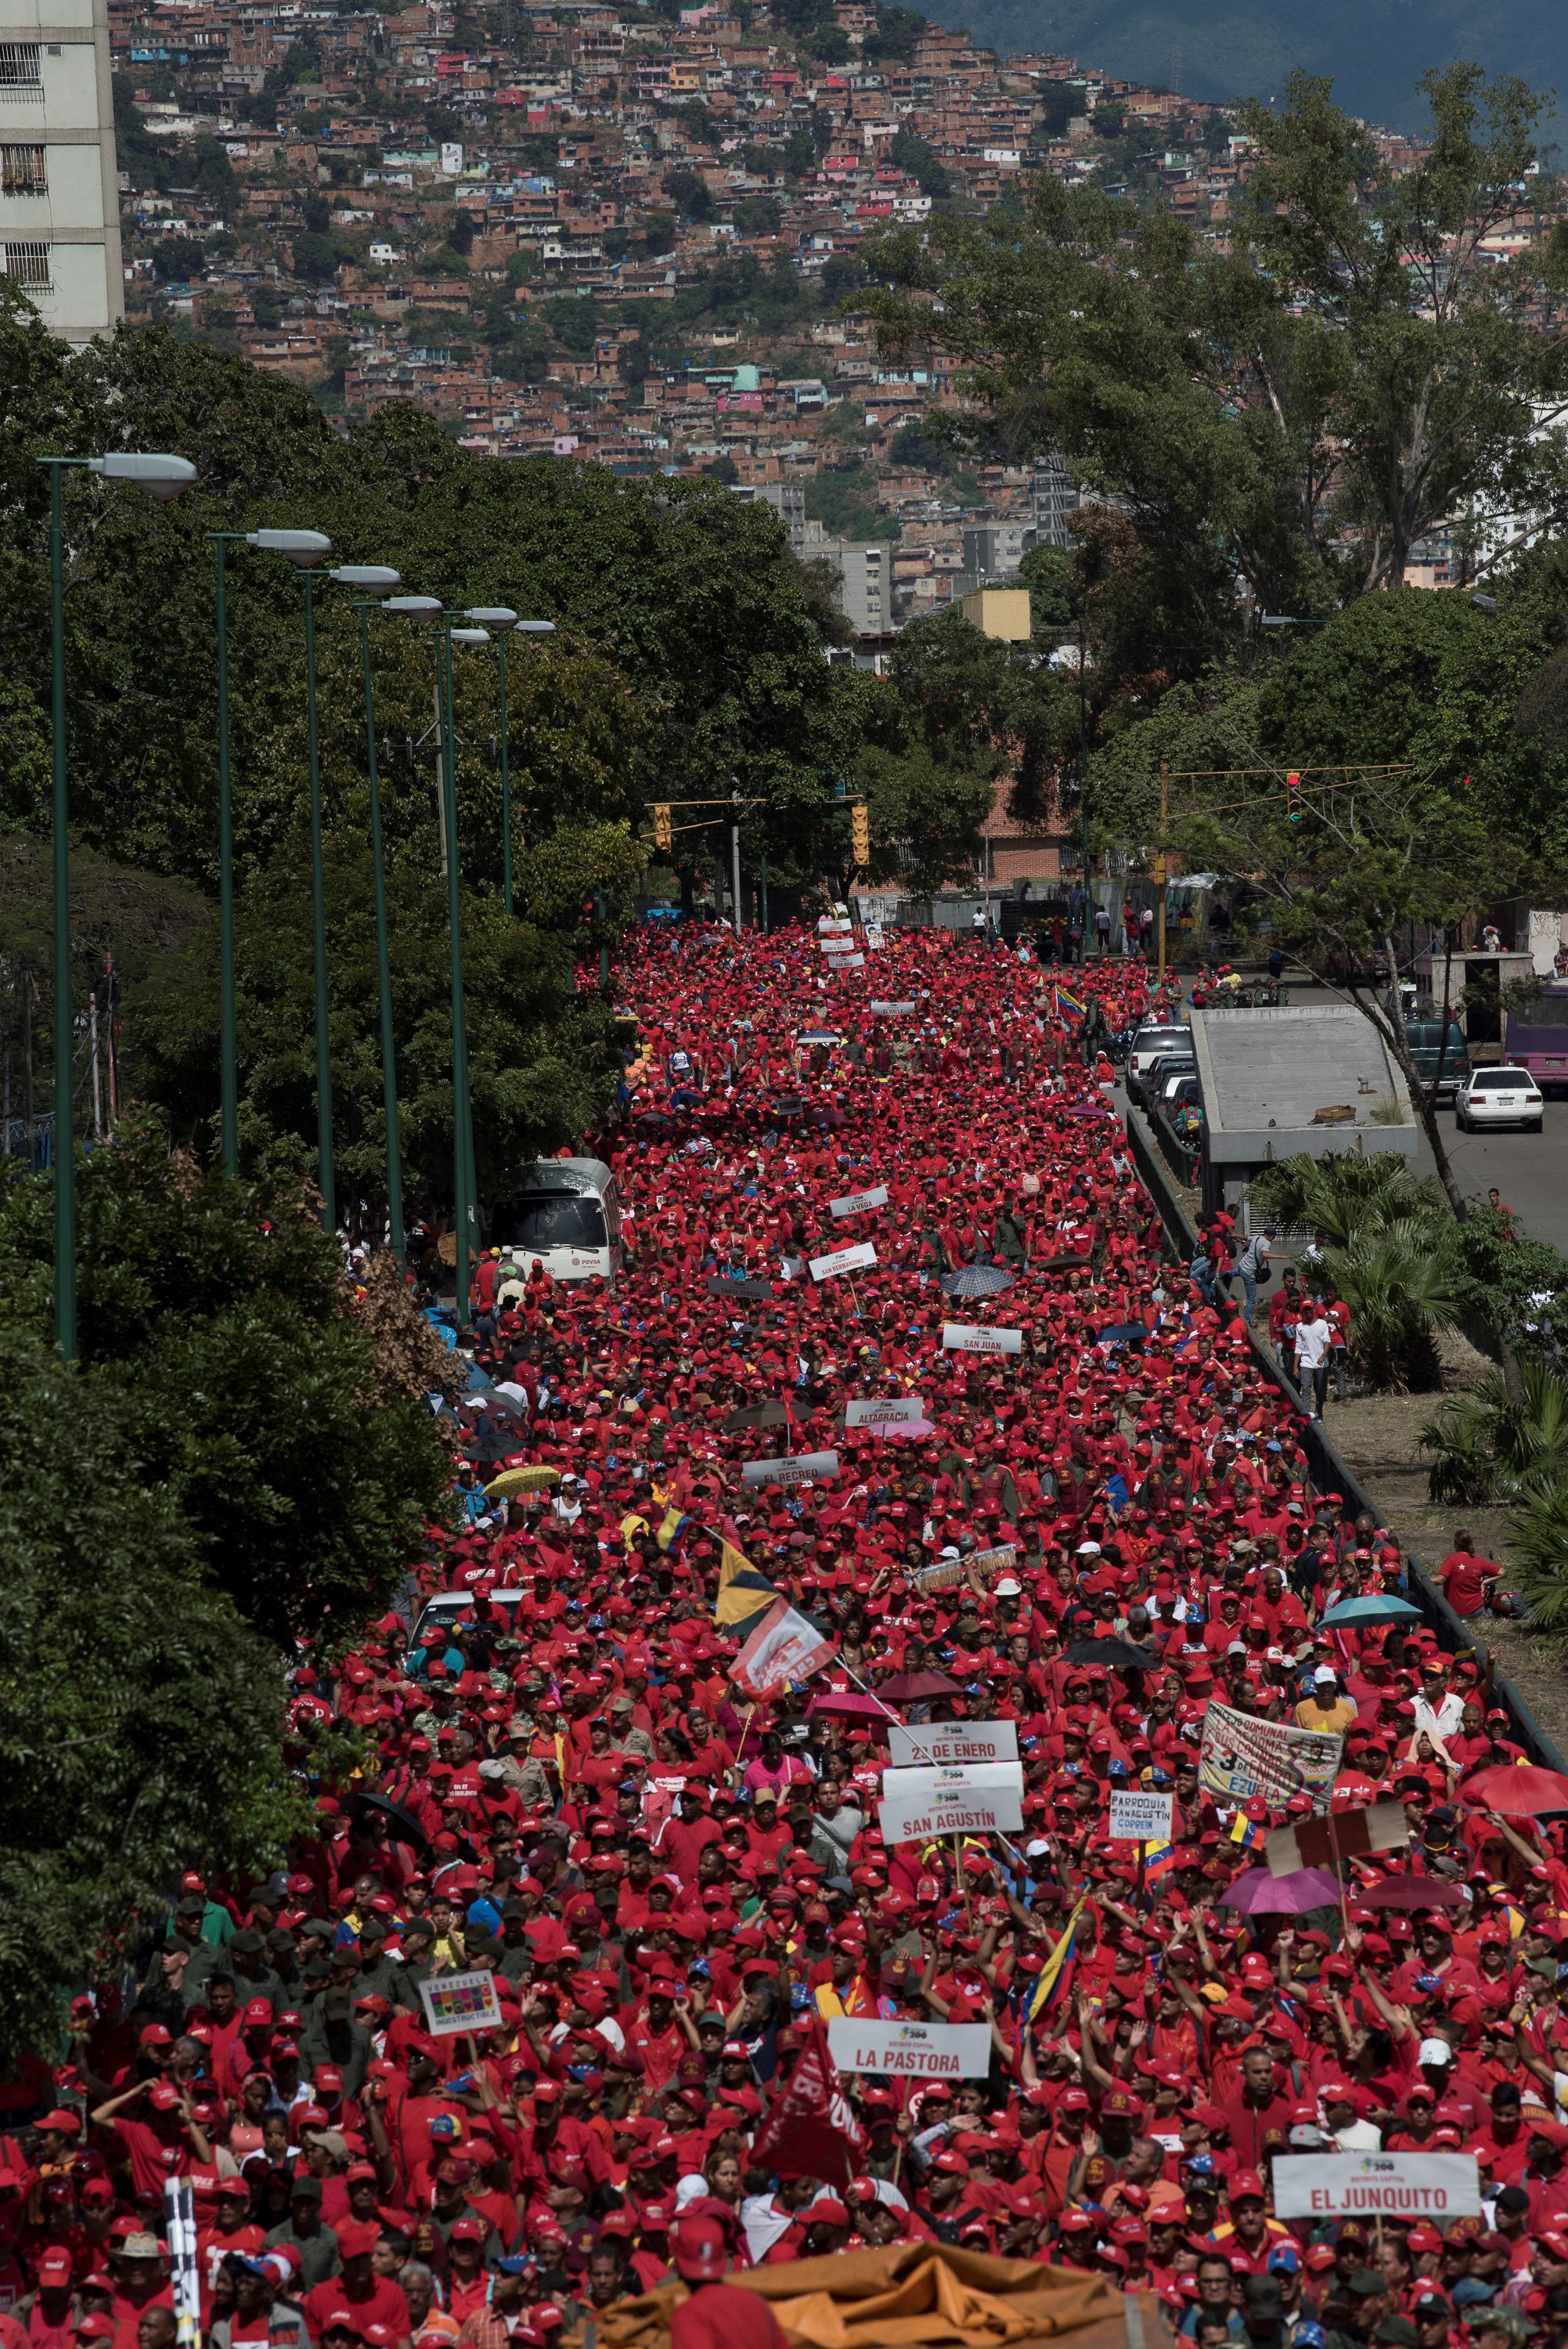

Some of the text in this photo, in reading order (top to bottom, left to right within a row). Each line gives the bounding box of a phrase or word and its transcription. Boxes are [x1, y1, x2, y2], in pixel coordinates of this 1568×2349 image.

[856, 1201, 873, 1209] VEGA
[833, 1258, 864, 1272] BERNARDINO
[980, 1341, 1001, 1350] JUAN
[858, 1412, 909, 1423] ALTAGRACIA
[764, 1468, 819, 1484] EL RECREO
[1208, 1704, 1243, 1727] CONCEJO
[1244, 1719, 1288, 1741] COMUNAL
[1217, 1719, 1230, 1731] LA
[933, 1744, 951, 1757] DE
[953, 1742, 996, 1756] ENERO
[1214, 1733, 1236, 1749] SUS
[1237, 1741, 1284, 1767] COLINAS
[1202, 1741, 1237, 1771] 23
[1238, 1763, 1248, 1772] DE
[1249, 1759, 1292, 1789] ENERO
[903, 1809, 995, 1836] SAN AGUSTÍN
[427, 1976, 490, 1993] VENEZUELA
[436, 2010, 497, 2026] INDESTRUCTIBLE
[910, 2030, 927, 2039] 200
[856, 2049, 960, 2072] LA PASTORA
[1310, 2188, 1447, 2210] EL JUNQUITO
